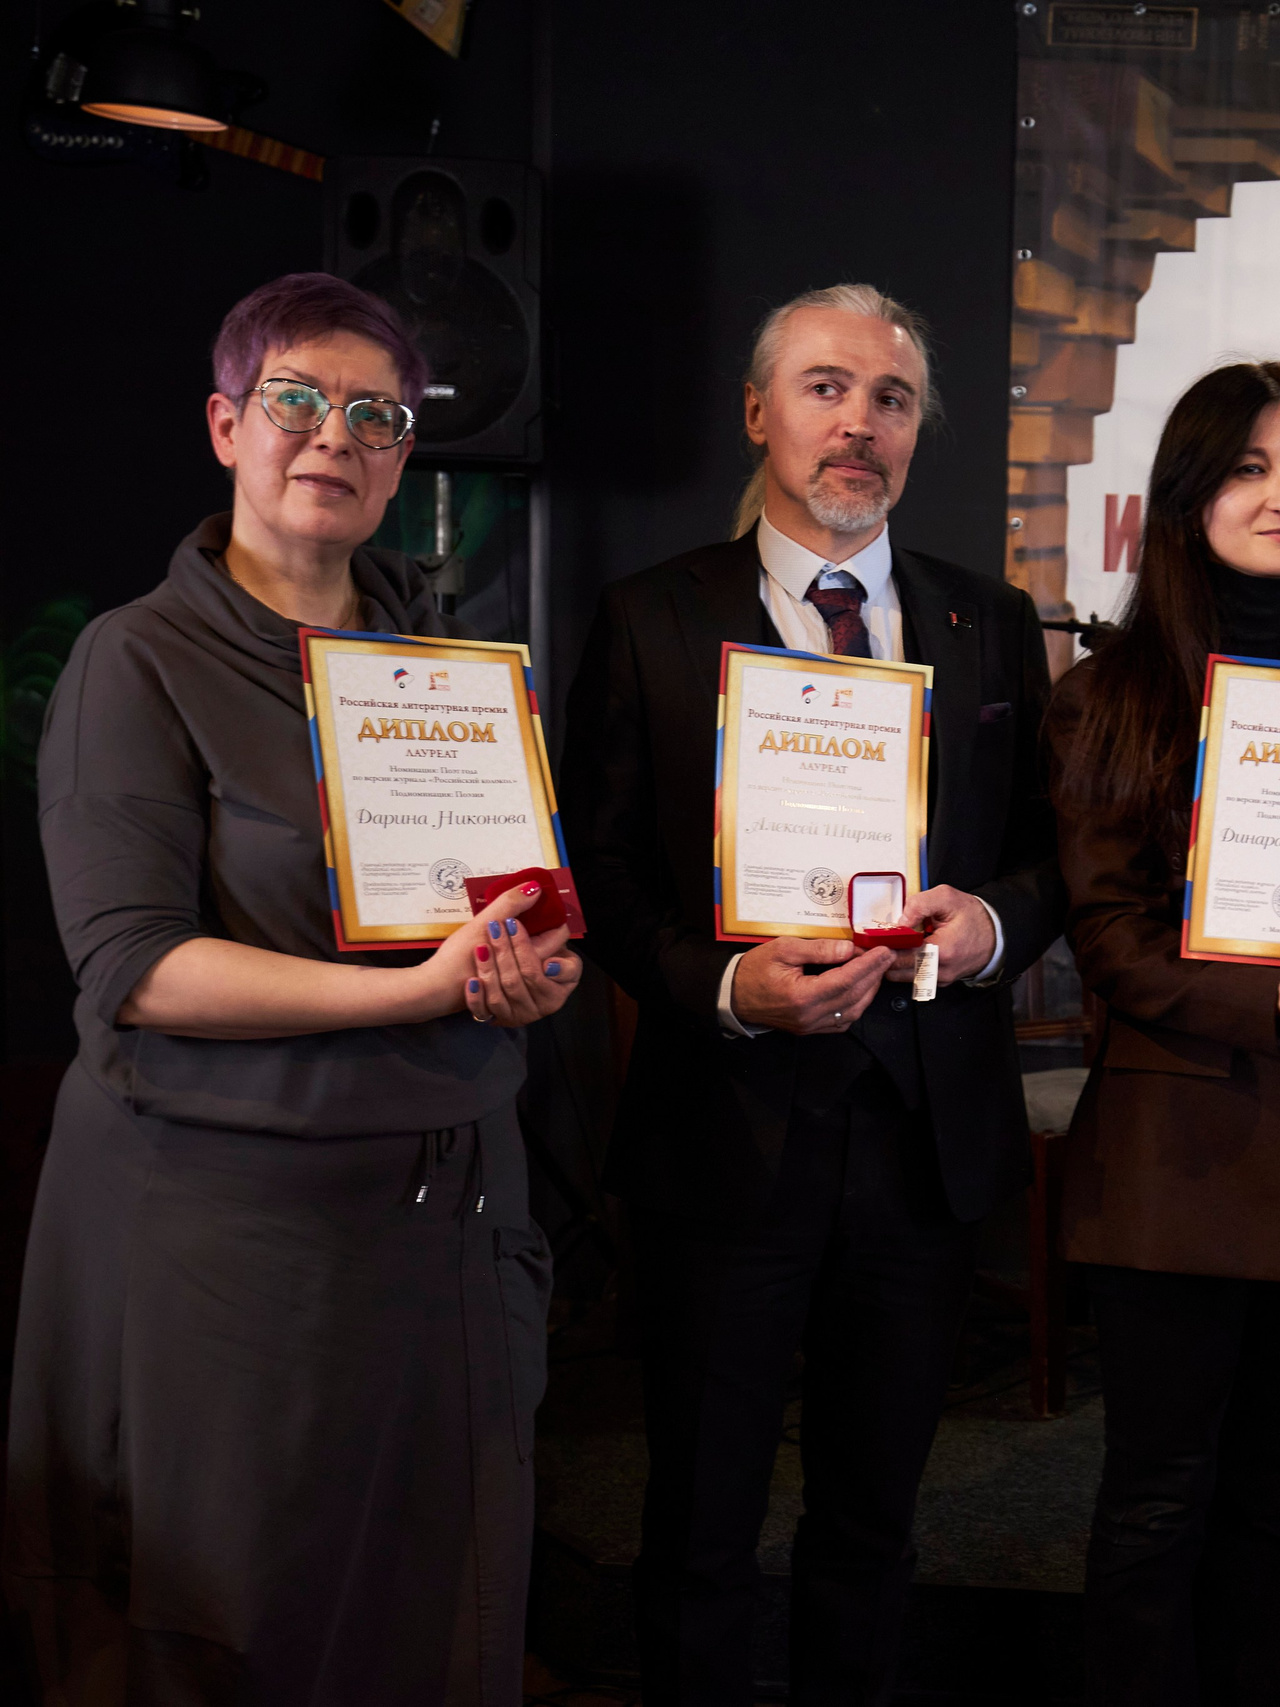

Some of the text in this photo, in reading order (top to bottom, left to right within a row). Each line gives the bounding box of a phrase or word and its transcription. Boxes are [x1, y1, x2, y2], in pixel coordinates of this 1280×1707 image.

[339, 696, 508, 715] Российская литературная премия
[357, 717, 498, 744] ДИПЛОМ
[748, 708, 902, 734] Российская литературная премия
[405, 749, 459, 759] ЛАУРЕАТ
[758, 729, 887, 762] ДИПЛОМ
[799, 762, 848, 775] ЛАУРЕАТ
[355, 808, 527, 830] Дарина Никонова
[745, 816, 893, 843] Алексей Ширяев
